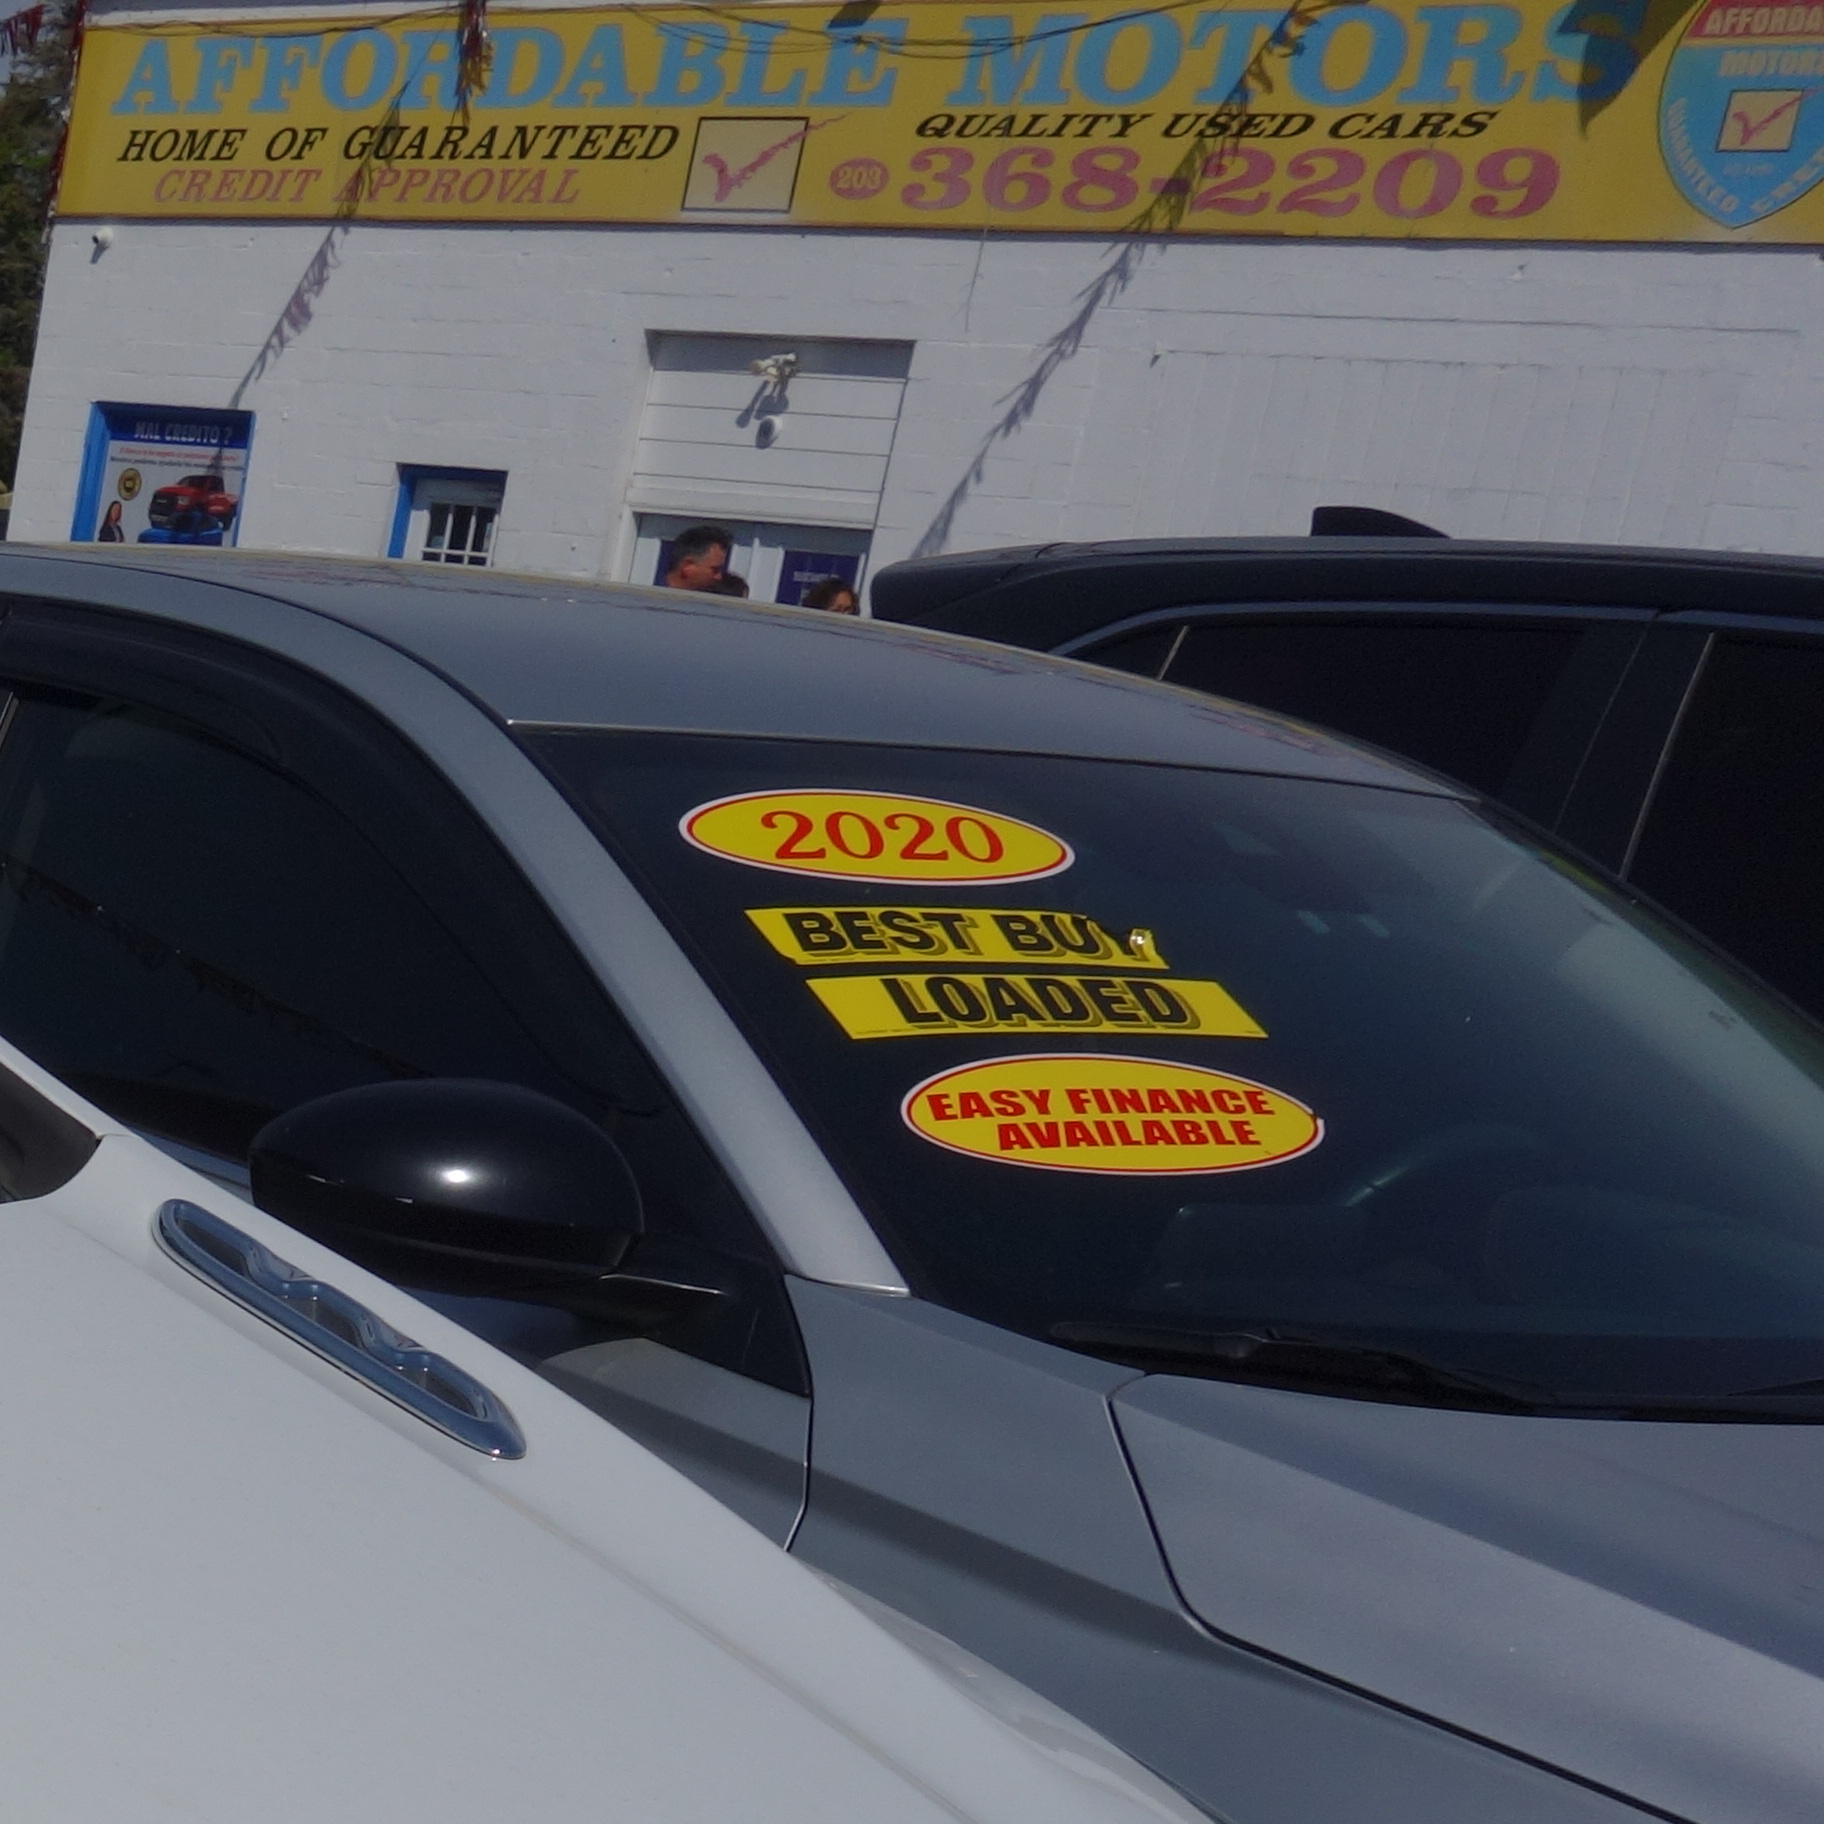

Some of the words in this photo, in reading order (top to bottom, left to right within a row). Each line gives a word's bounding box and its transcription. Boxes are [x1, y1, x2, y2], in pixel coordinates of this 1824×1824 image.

[111, 17, 910, 116] AFFORDABLE
[945, 0, 1648, 108] MOTORS
[117, 128, 246, 162] HOME
[265, 127, 328, 162] OF
[343, 125, 680, 161] GUARANTEED
[915, 113, 1155, 139] QUALITY
[1162, 112, 1315, 140] USED
[1328, 109, 1500, 140] CARS
[154, 168, 323, 203] CREDIT
[333, 168, 581, 205] APPROVAL
[900, 146, 1561, 220] 368-2209
[760, 811, 1004, 863] 2020
[783, 911, 972, 954] BEST
[880, 977, 1194, 1027] LOADED
[926, 1089, 1051, 1121] EASY
[1065, 1088, 1275, 1116] FINANCE
[997, 1120, 1261, 1151] AVAILABLE
